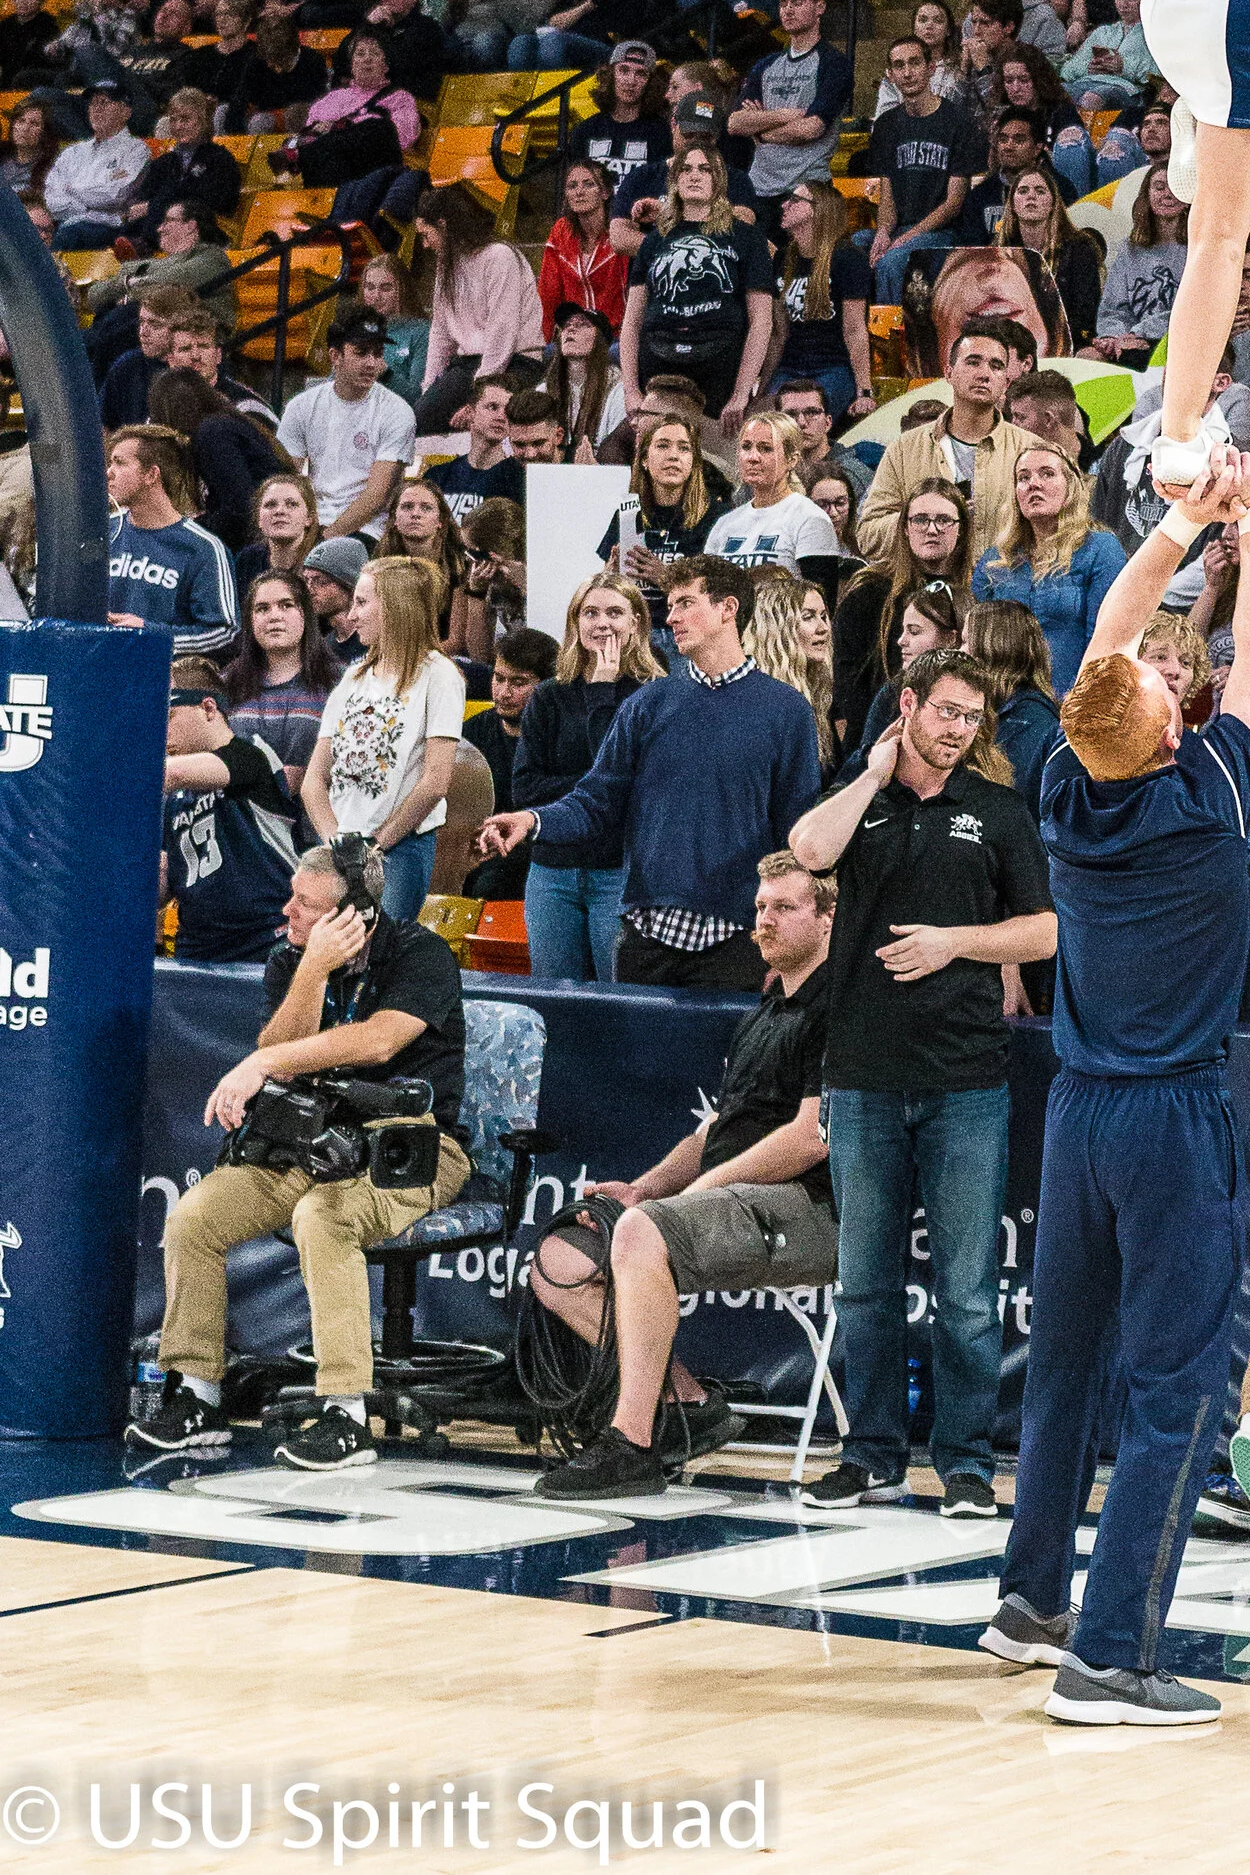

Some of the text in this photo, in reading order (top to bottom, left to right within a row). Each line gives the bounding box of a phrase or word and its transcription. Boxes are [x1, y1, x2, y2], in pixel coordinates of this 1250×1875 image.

[620, 500, 641, 512] UTA
[109, 552, 180, 590] didas
[179, 814, 224, 888] 13
